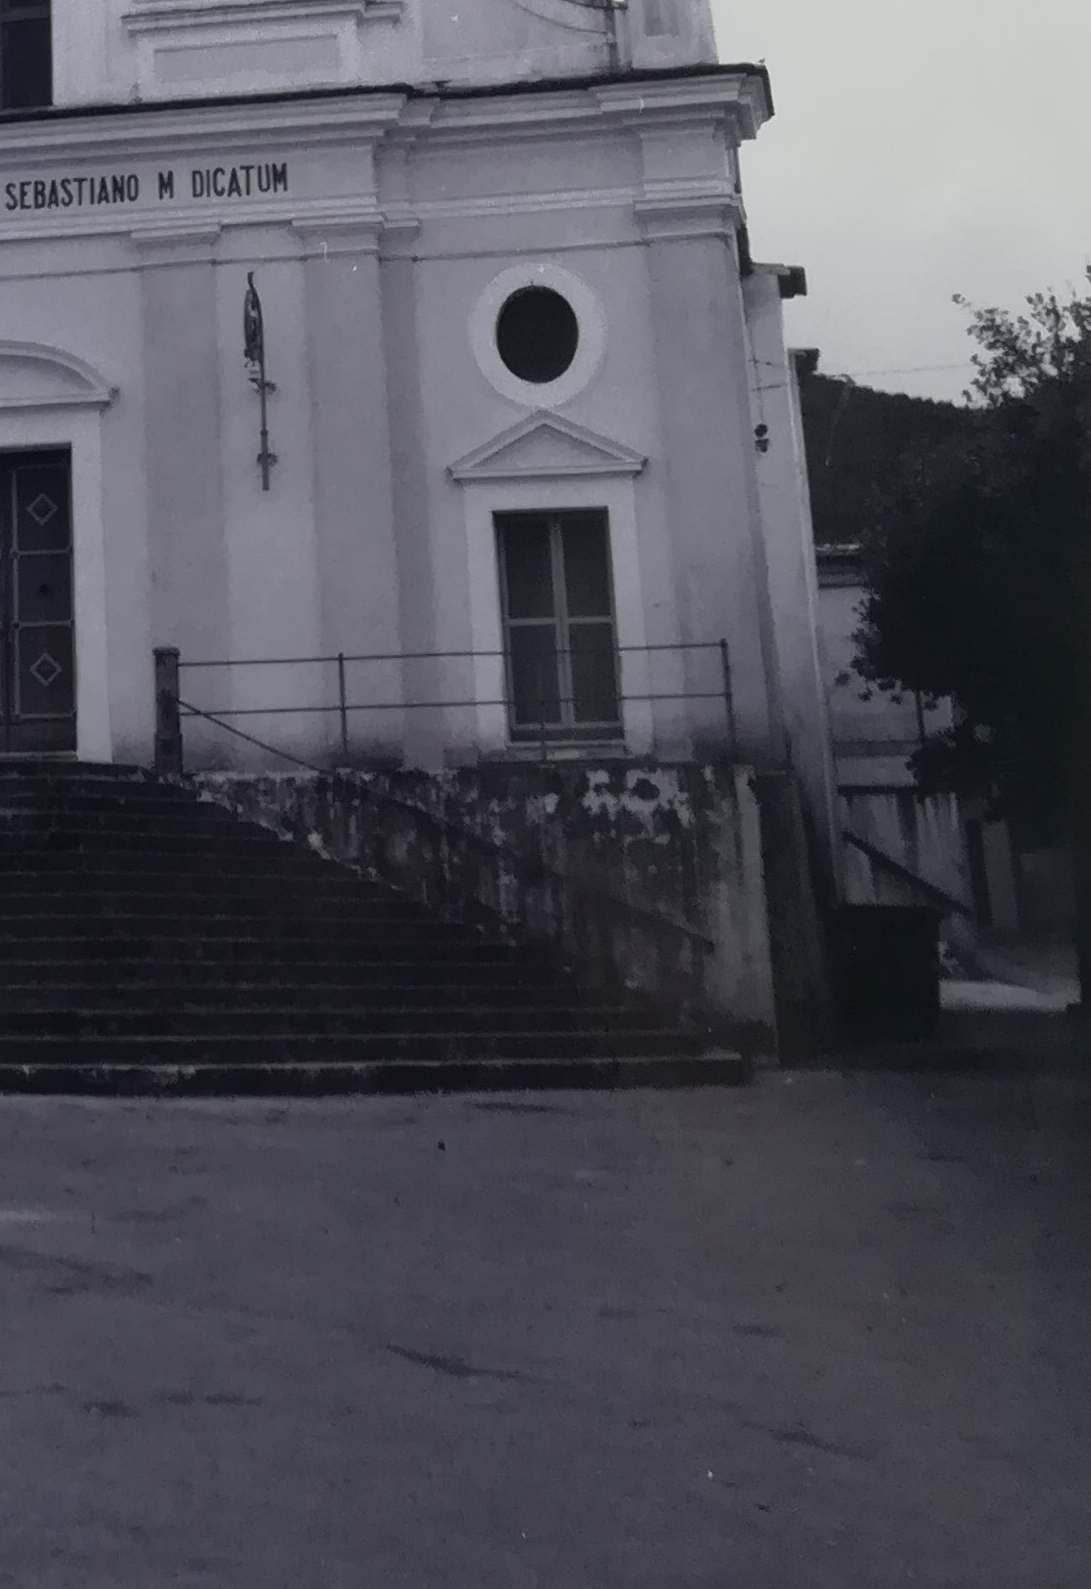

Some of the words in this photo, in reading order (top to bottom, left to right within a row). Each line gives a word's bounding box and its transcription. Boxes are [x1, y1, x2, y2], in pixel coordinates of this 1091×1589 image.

[5, 174, 140, 212] SEBASTIANO
[158, 171, 175, 201] M
[192, 162, 289, 199] DICATUM
